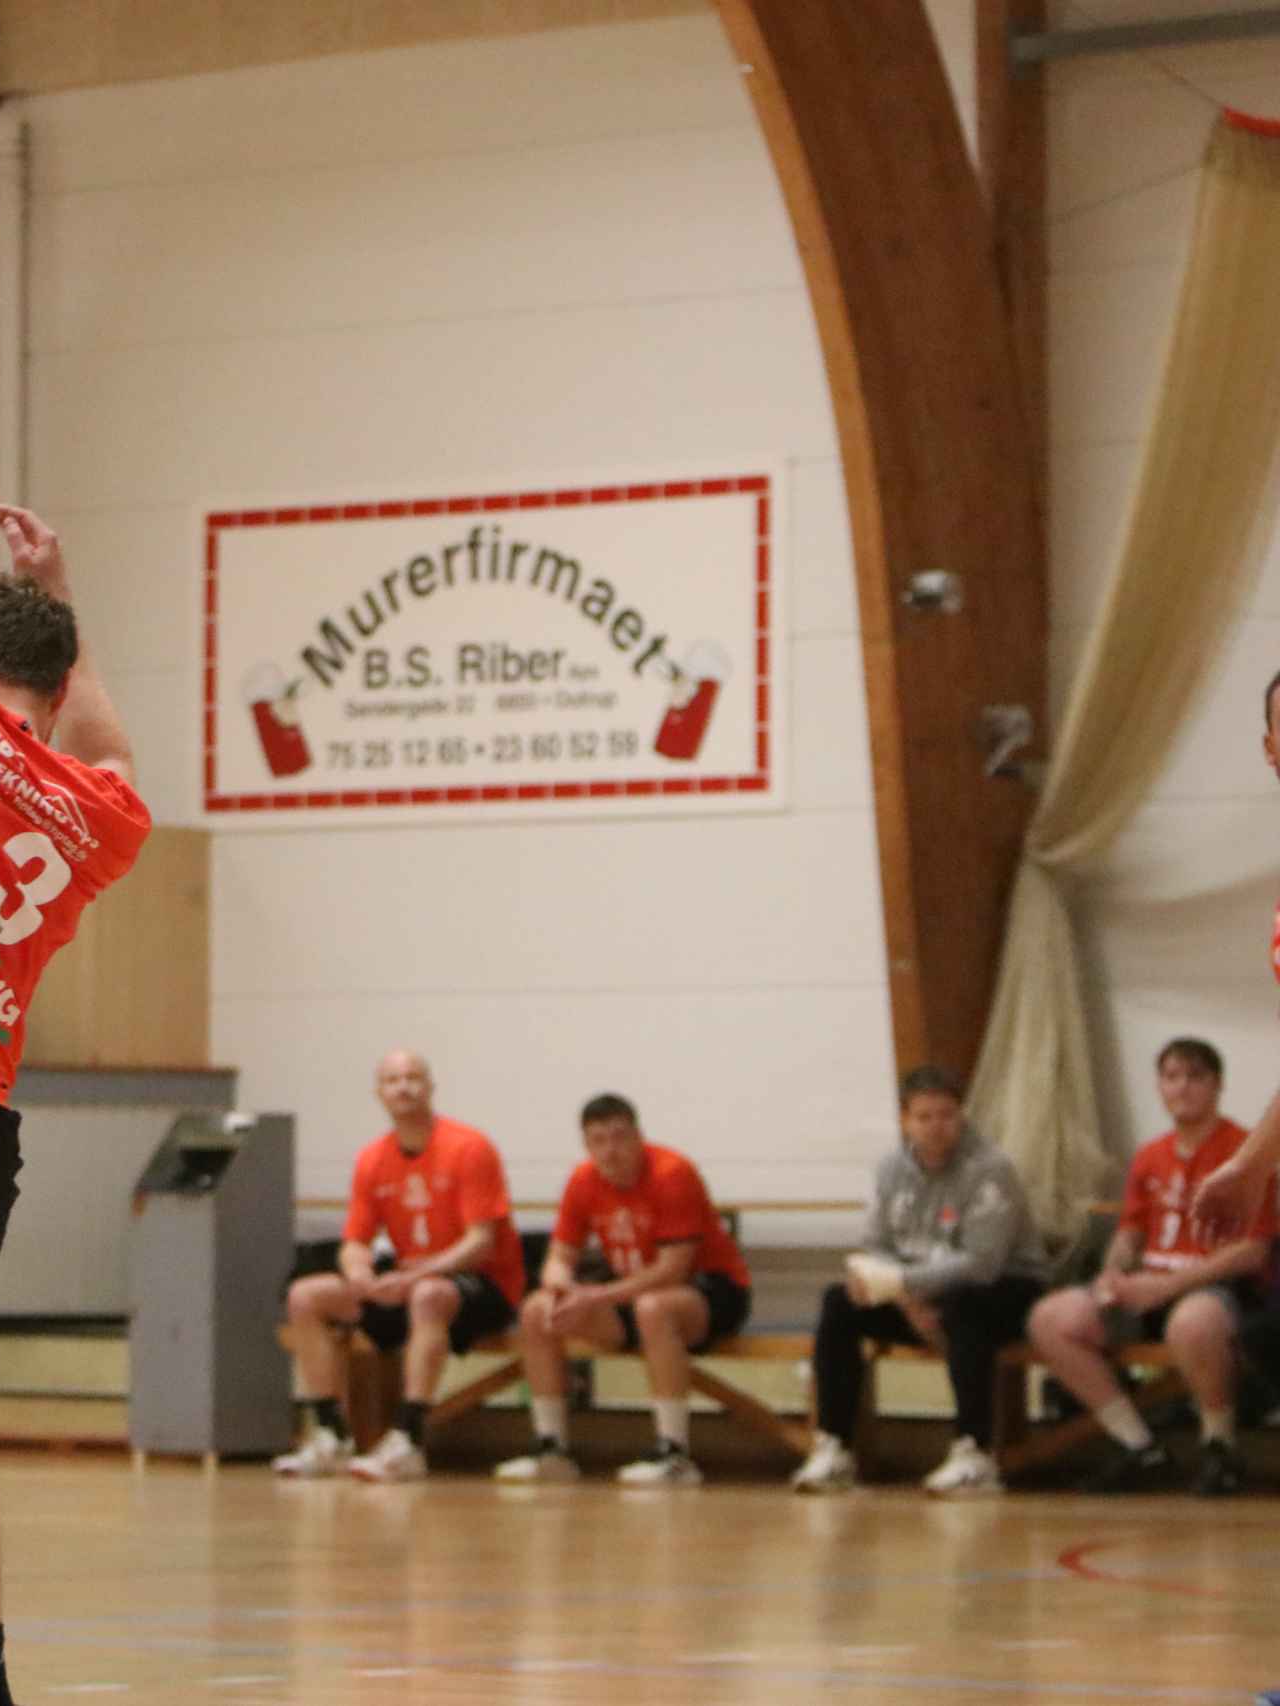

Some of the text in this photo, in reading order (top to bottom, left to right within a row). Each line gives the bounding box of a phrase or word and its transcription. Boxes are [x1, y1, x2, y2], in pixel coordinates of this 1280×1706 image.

[300, 525, 668, 689] Murerfirmaet
[363, 645, 443, 690] B.S.
[458, 642, 565, 684] Riber
